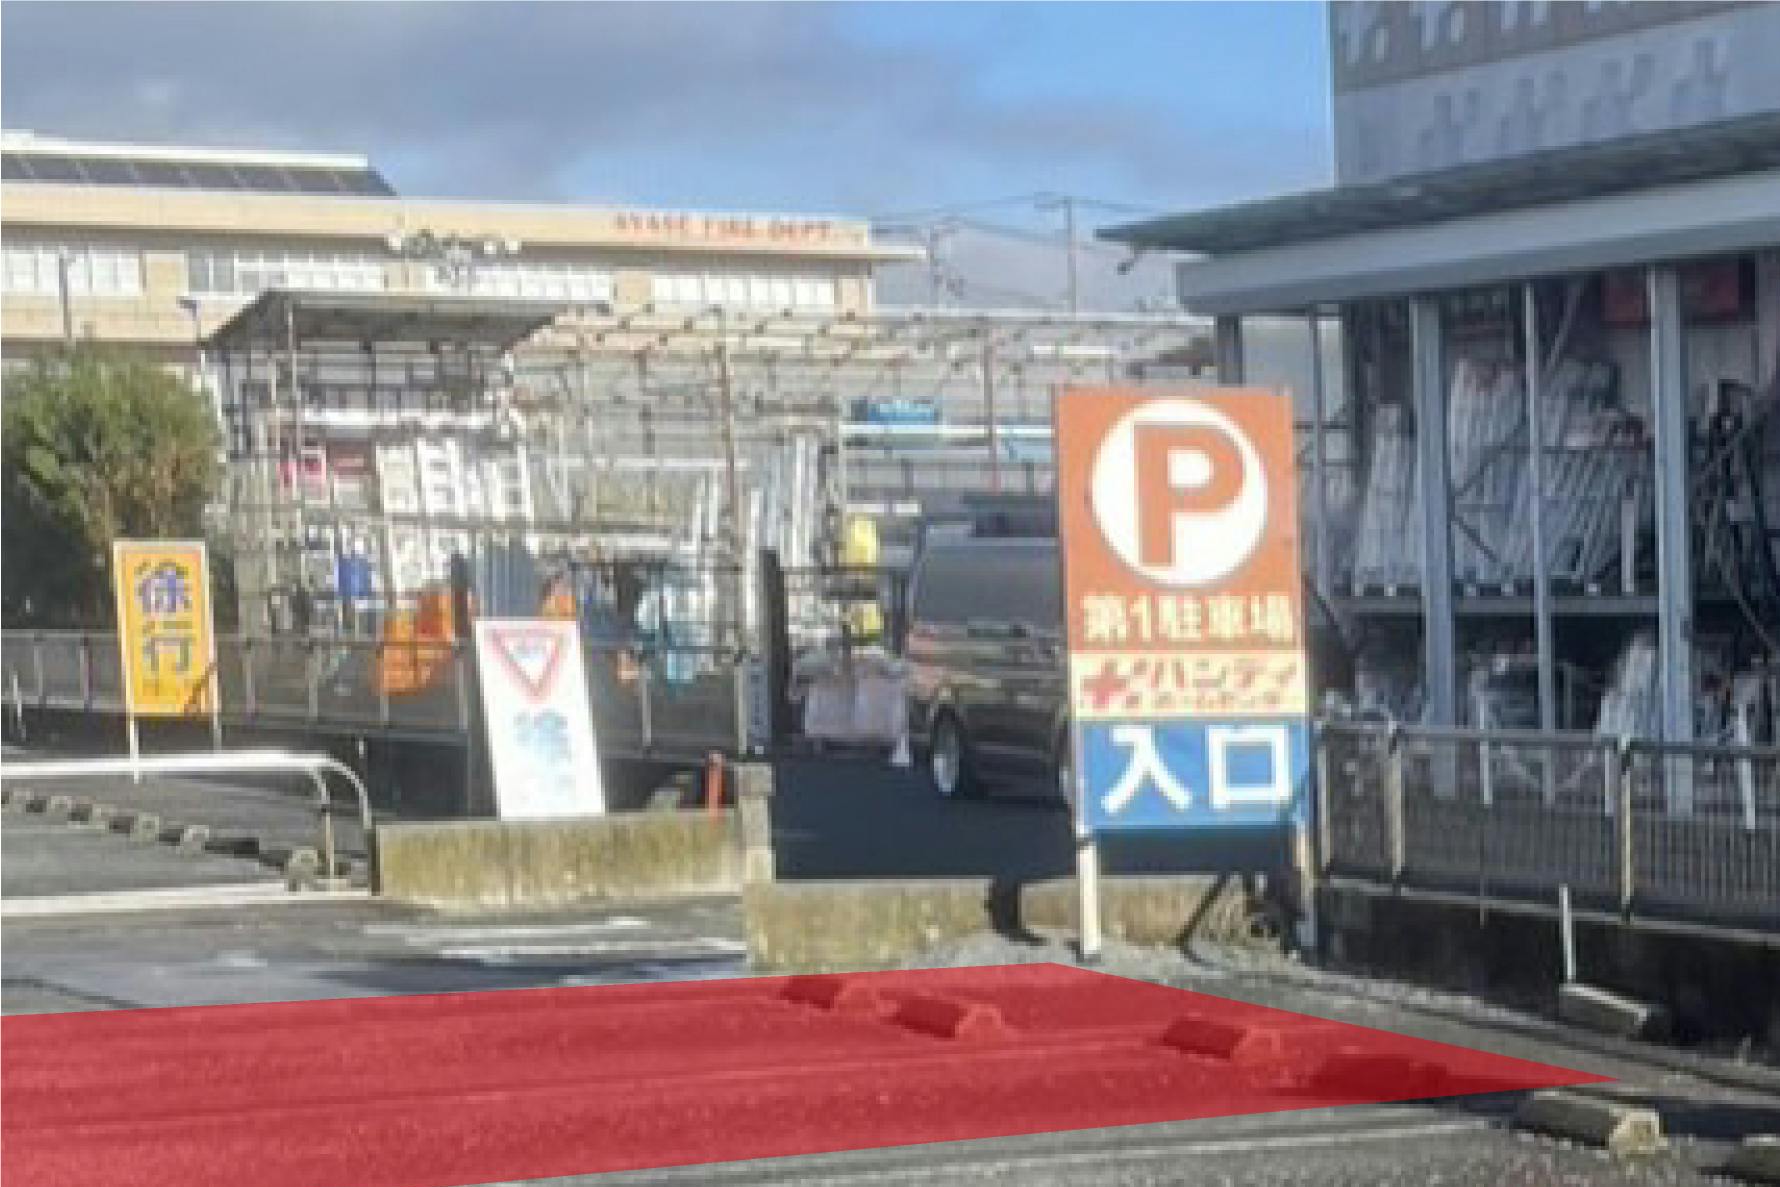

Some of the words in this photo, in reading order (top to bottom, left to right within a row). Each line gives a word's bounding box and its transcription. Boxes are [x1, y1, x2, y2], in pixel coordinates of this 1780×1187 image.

[1134, 422, 1245, 566] P
[1080, 591, 1296, 642] 第1駐車場
[1099, 723, 1289, 815] 入口
